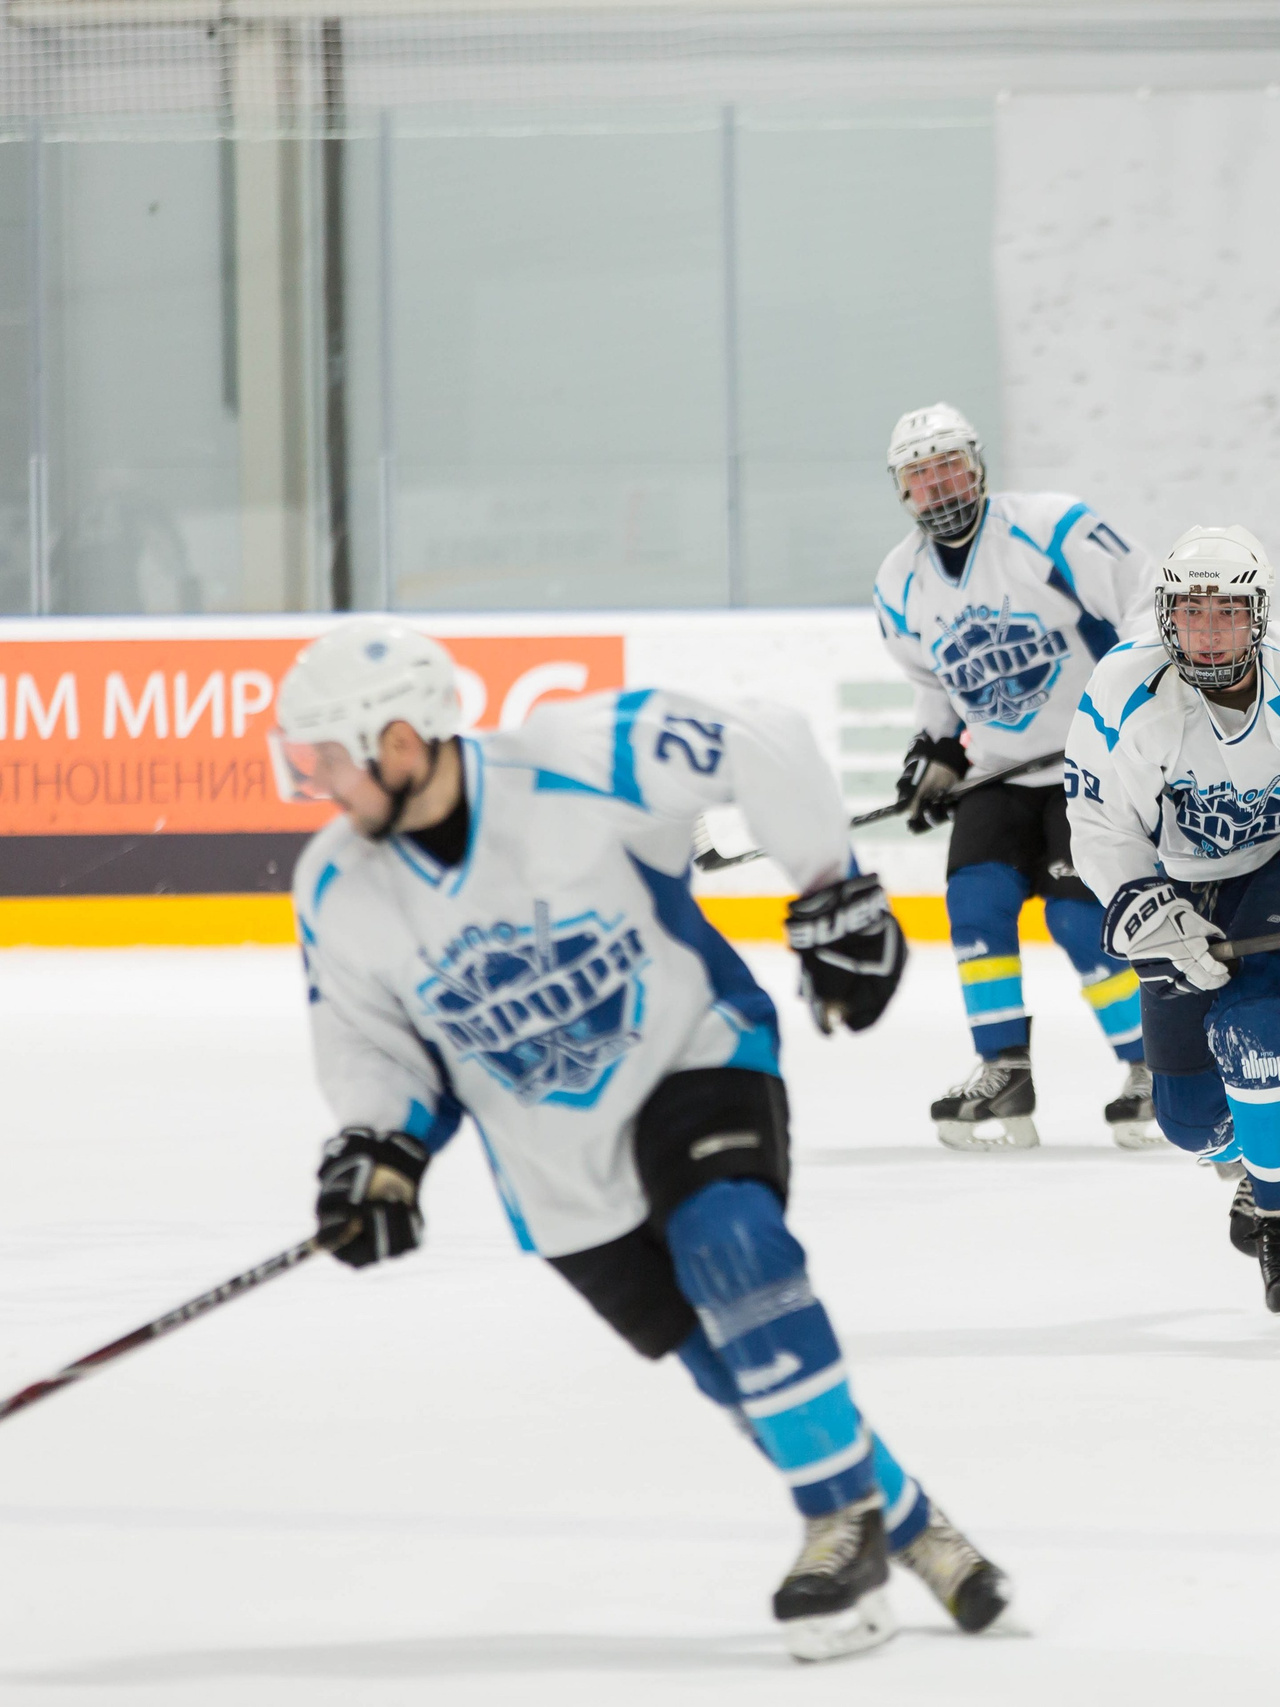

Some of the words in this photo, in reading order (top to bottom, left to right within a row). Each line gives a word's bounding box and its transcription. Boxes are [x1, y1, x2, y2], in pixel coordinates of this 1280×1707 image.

[1187, 570, 1221, 579] Reebok
[102, 669, 274, 739] МИР
[0, 758, 266, 806] ТНОШЕНИЯ
